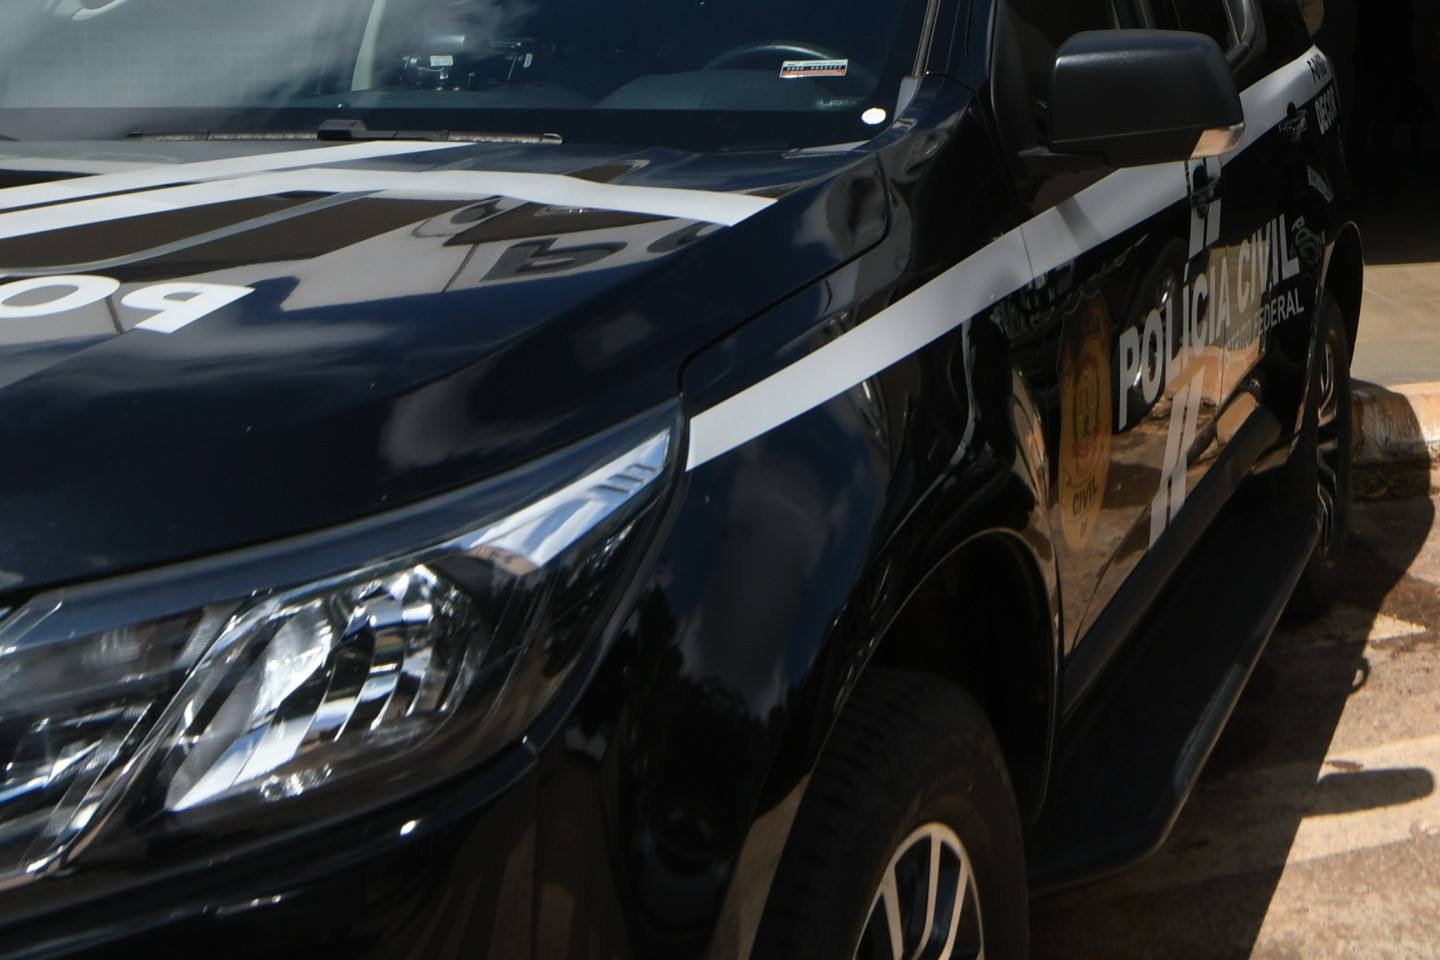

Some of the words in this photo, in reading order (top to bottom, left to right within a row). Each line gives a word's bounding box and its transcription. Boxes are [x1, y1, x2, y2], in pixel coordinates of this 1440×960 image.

[1118, 254, 1231, 431] POLÍCIA
[1237, 213, 1301, 313] CIVIL
[1253, 287, 1305, 339] FEDERAL
